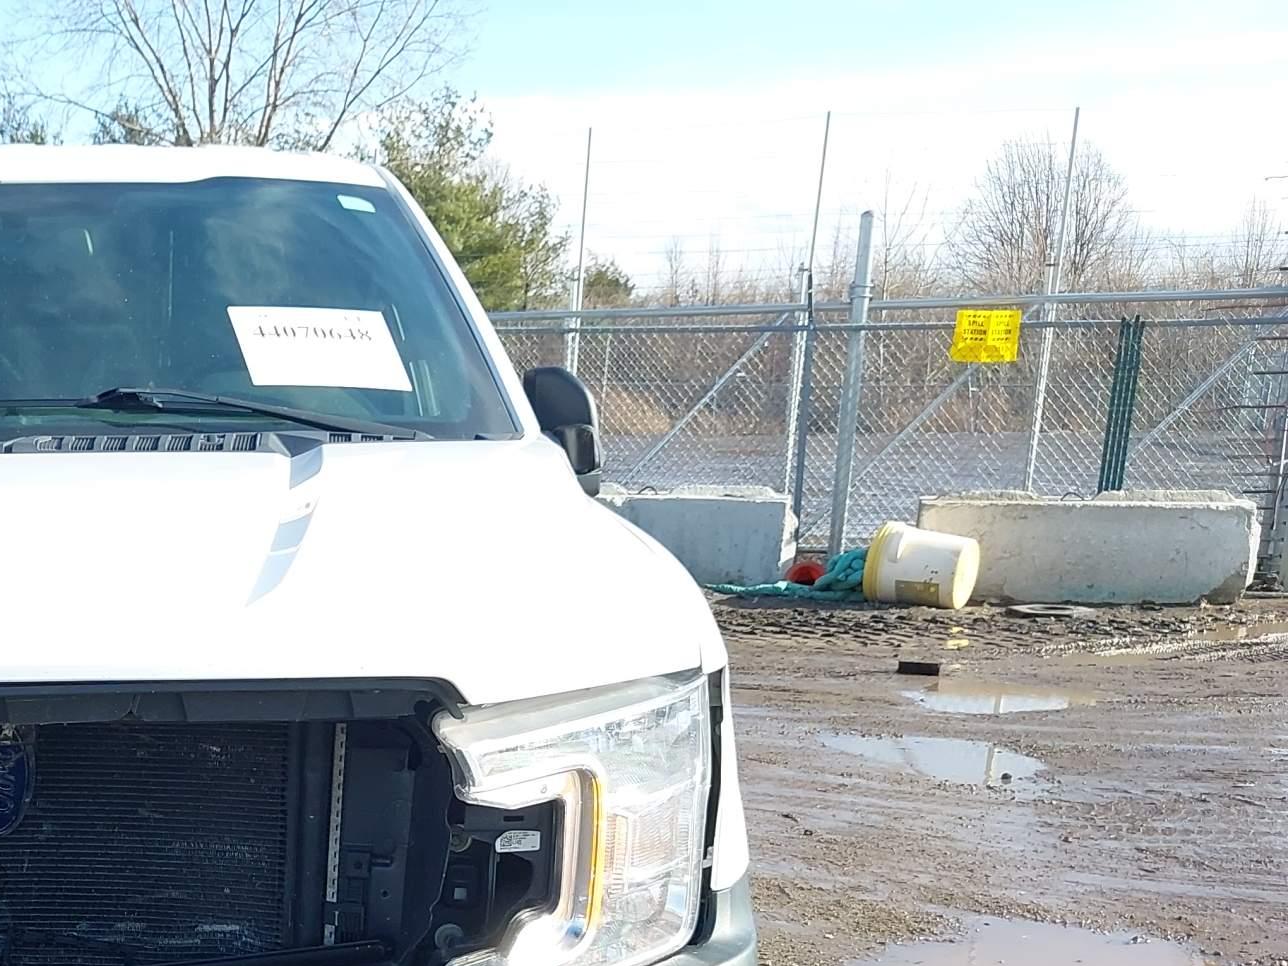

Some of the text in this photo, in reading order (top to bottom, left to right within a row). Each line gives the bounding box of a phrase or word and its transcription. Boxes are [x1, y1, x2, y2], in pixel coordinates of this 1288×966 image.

[967, 319, 985, 327] SPILL
[252, 324, 373, 342] 44070648
[963, 328, 987, 336] STATION
